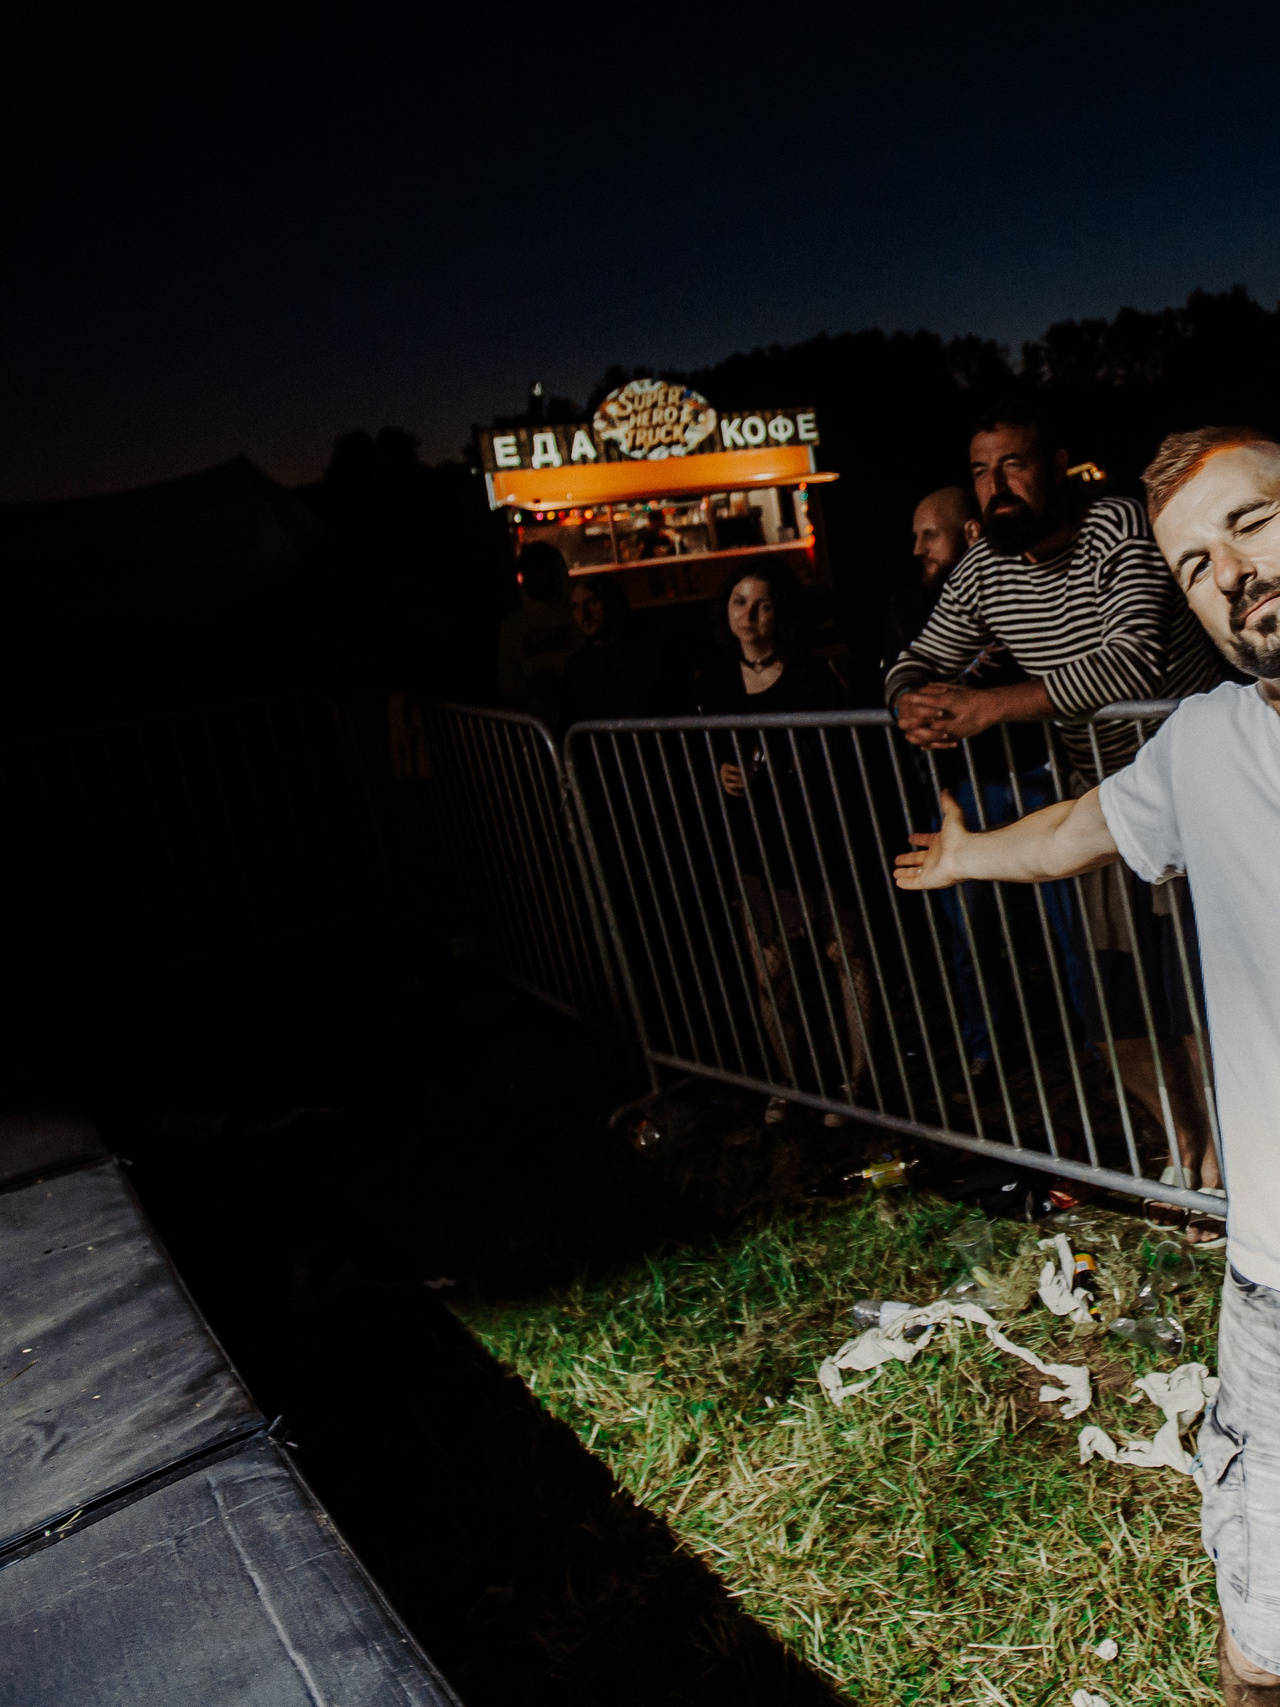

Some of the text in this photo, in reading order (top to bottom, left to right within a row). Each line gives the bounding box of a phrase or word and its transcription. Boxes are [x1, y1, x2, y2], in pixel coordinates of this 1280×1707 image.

[613, 387, 682, 416] SUPER
[625, 422, 688, 451] TRUCK
[720, 413, 819, 448] КОФЕ
[493, 430, 597, 469] ЕДА
